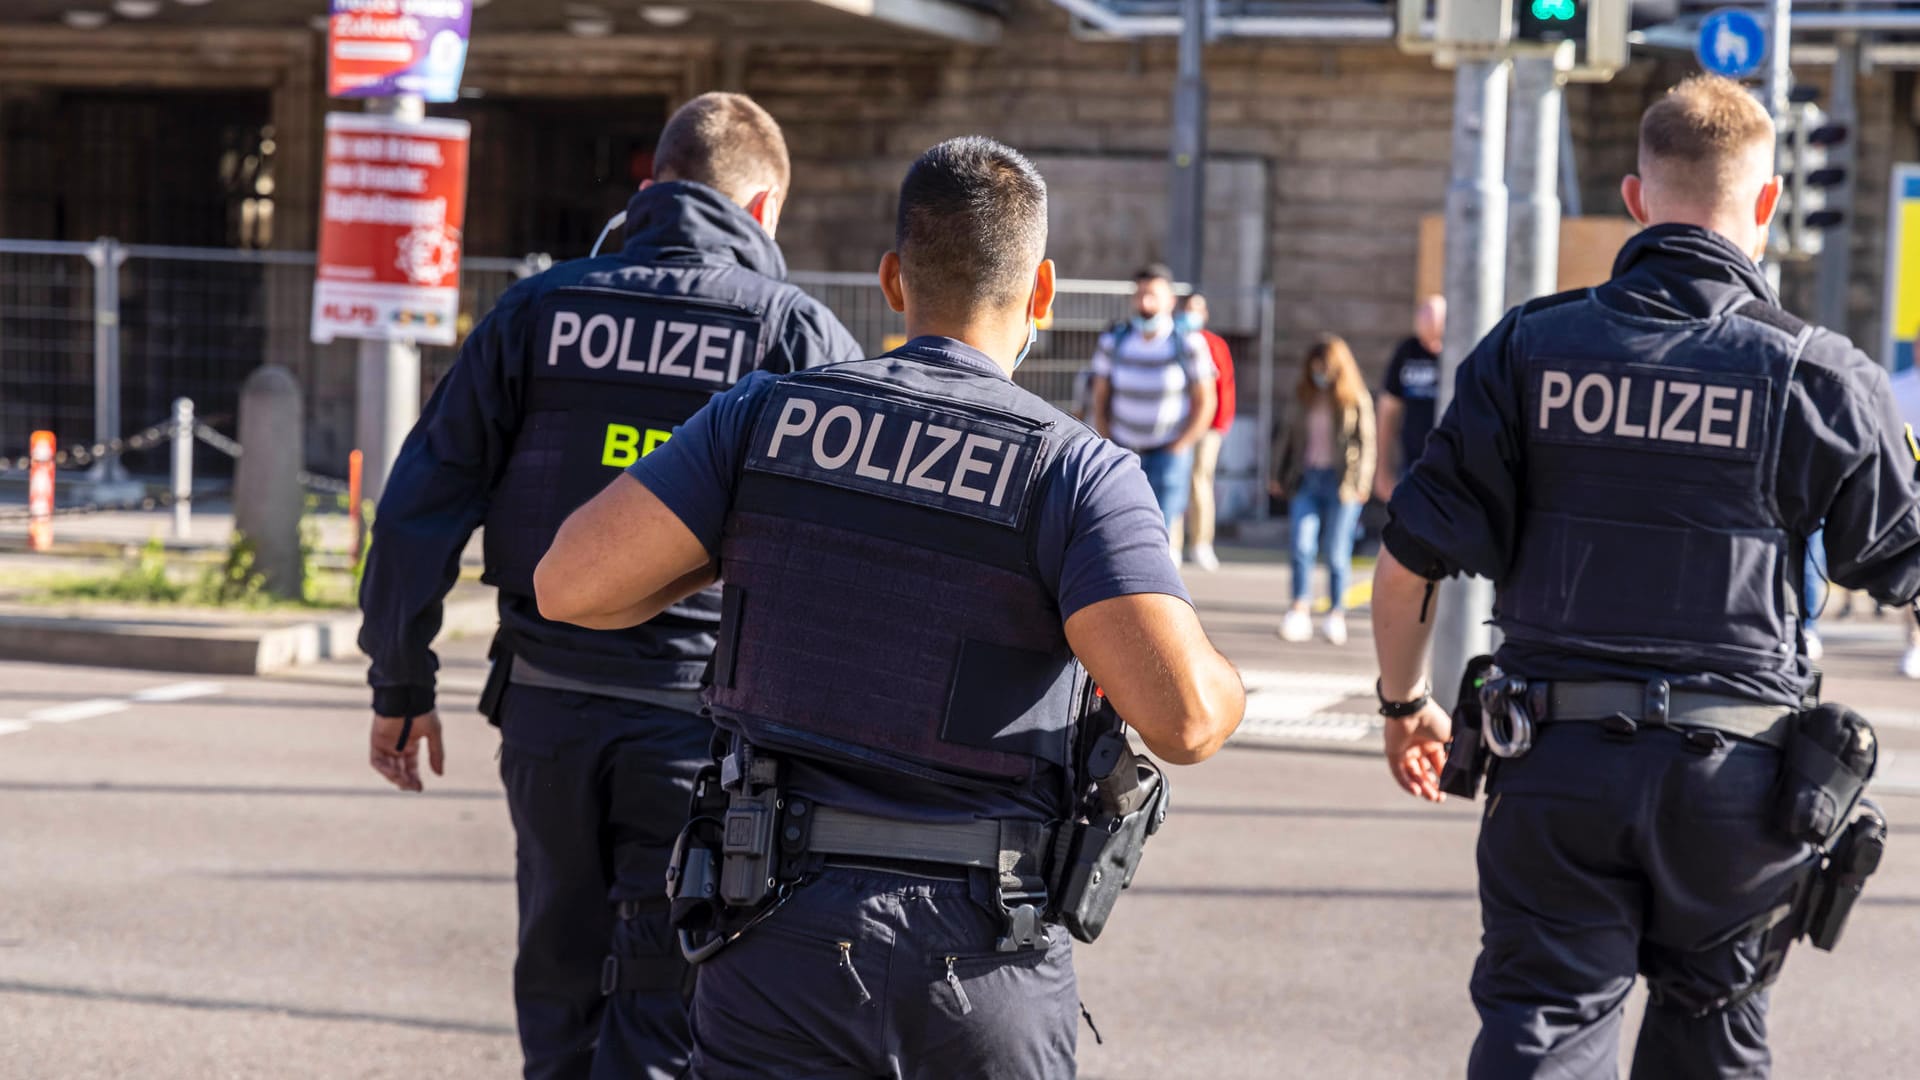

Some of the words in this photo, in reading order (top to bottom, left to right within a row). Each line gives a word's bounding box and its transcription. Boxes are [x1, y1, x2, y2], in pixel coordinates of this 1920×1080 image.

[548, 311, 745, 384] POLIZEI
[1539, 370, 1753, 449] POLIZEI
[767, 397, 1020, 507] POLIZEI
